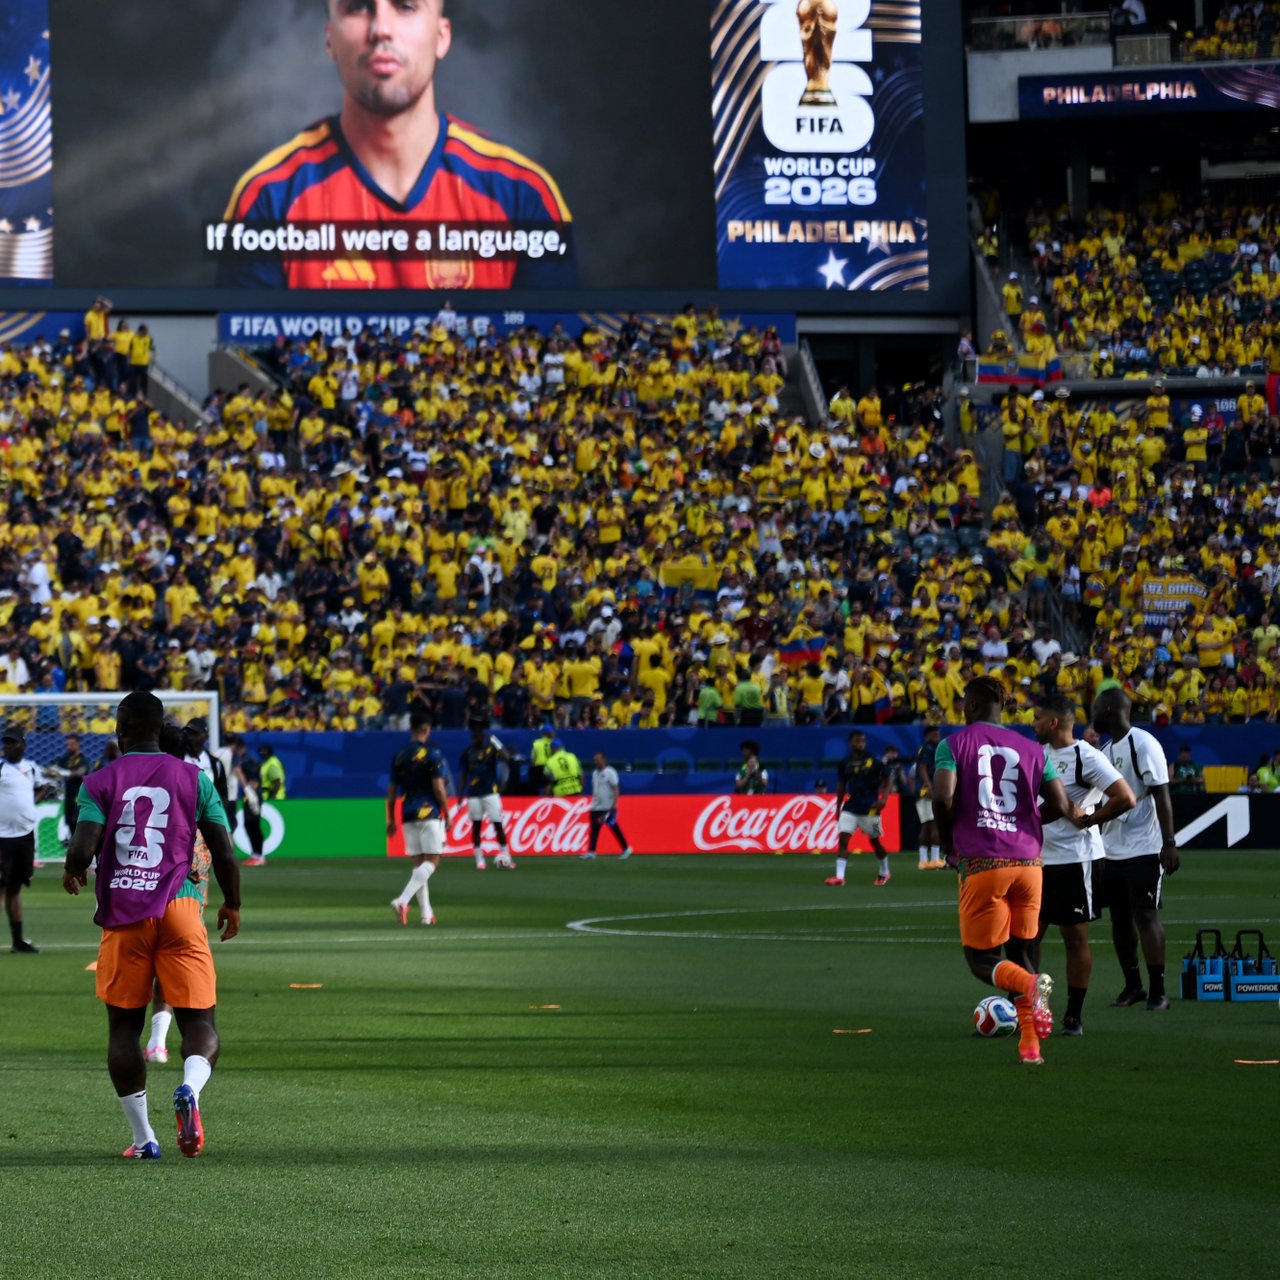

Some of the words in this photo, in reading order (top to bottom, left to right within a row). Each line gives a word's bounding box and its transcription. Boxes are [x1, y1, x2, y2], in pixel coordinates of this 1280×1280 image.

[1043, 80, 1197, 105] PHILADELPHIA
[796, 117, 844, 133] FIFA
[764, 157, 834, 176] WORLD
[836, 158, 876, 176] CUP
[764, 177, 877, 206] 2026
[206, 223, 225, 251] If
[232, 223, 336, 251] football
[341, 229, 410, 251] were
[415, 230, 432, 251] a
[439, 224, 567, 257] language,
[727, 220, 916, 243] PHILADELPHIA
[230, 316, 278, 336] FIFA
[693, 795, 840, 851] Coca-Cola
[977, 818, 1017, 832] 2026
[128, 850, 149, 861] FIFA
[114, 868, 140, 877] WORLD
[141, 871, 160, 879] CUP
[110, 876, 158, 891] 2026
[1237, 984, 1279, 993] POWERADE
